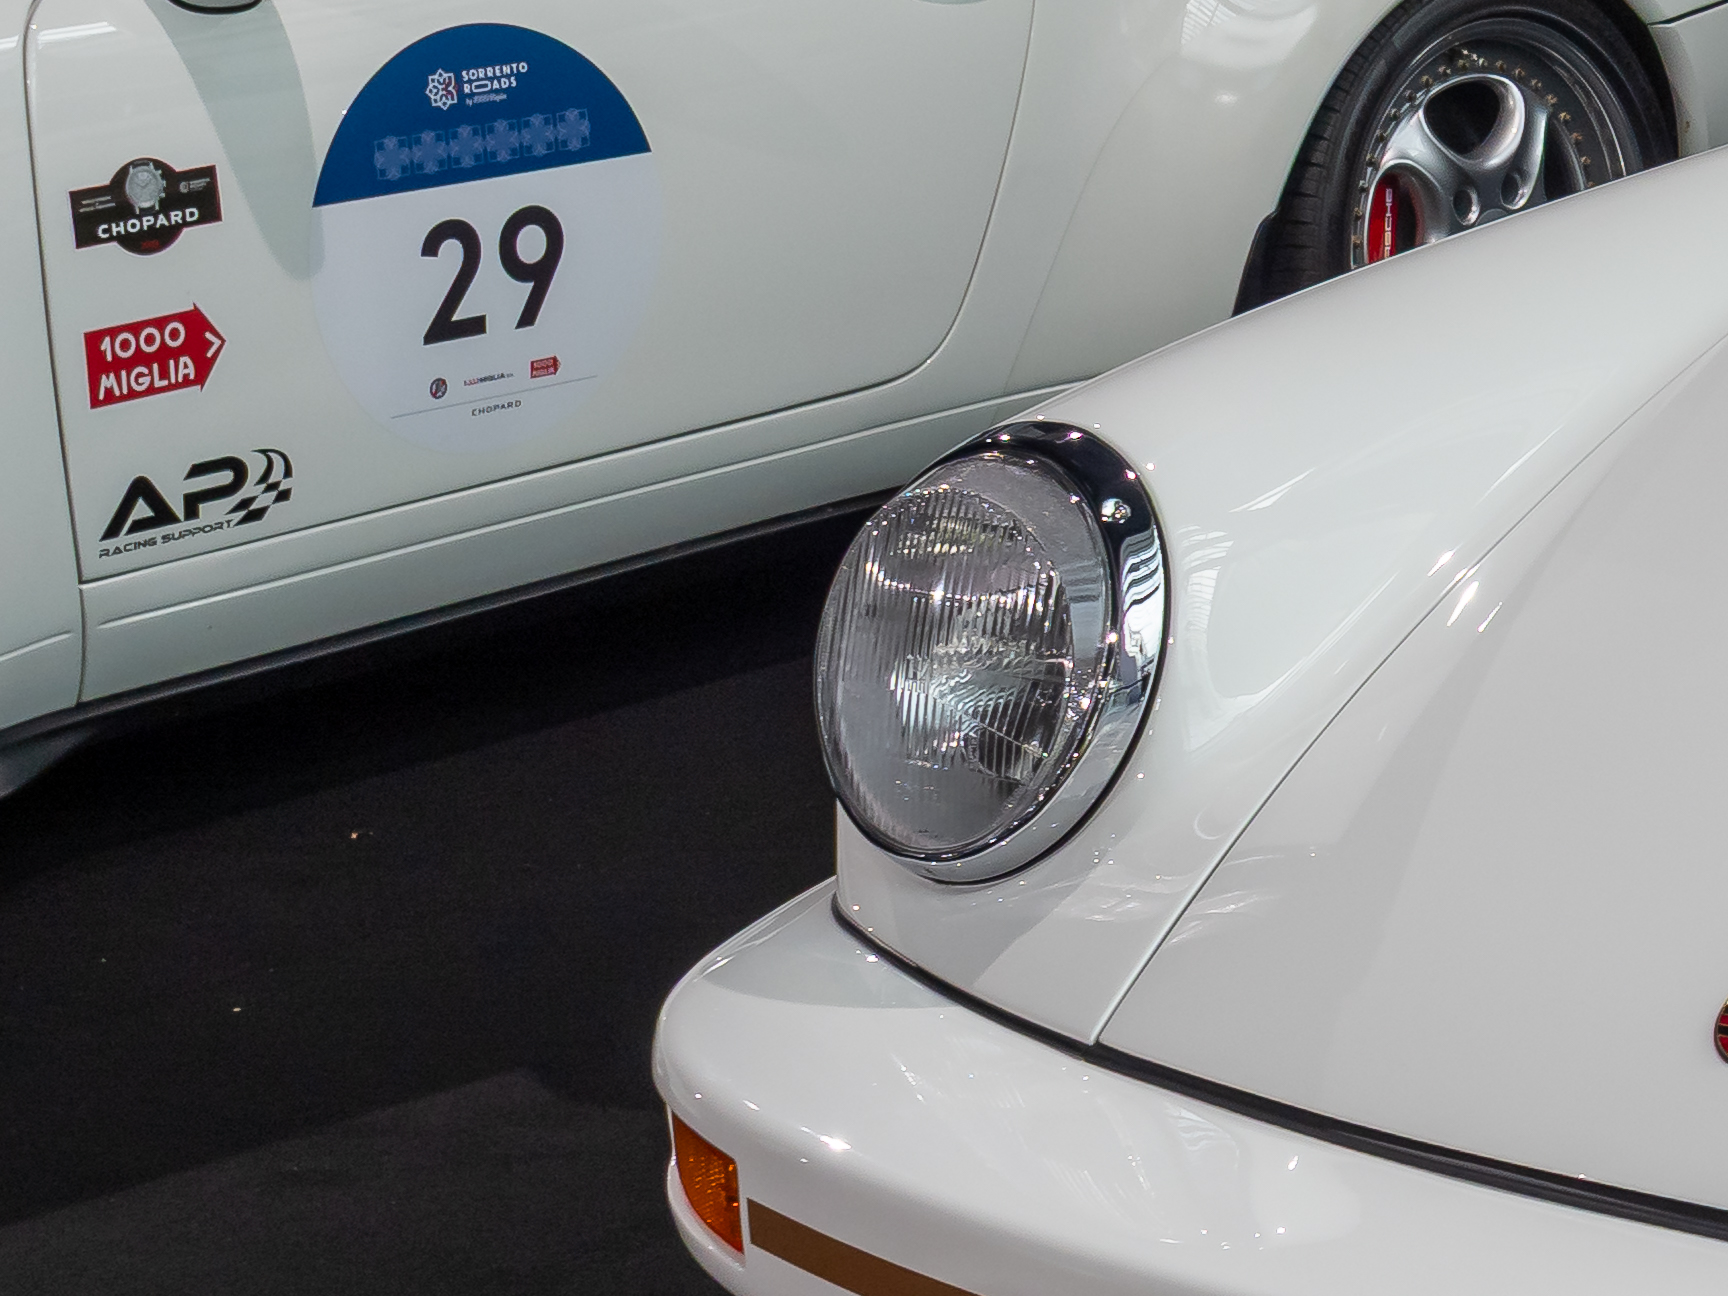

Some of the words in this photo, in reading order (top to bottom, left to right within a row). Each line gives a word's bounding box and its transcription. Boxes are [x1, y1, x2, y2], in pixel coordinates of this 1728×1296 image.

[461, 61, 528, 81] SORRENTO
[463, 76, 517, 94] ROADS
[97, 207, 200, 239] CHOPARD
[419, 204, 565, 346] 29
[100, 320, 186, 362] 1000
[98, 355, 195, 401] MIGLIA
[471, 399, 522, 416] CHOPARD
[98, 536, 158, 559] RACING
[160, 518, 235, 545] SUPPORT
